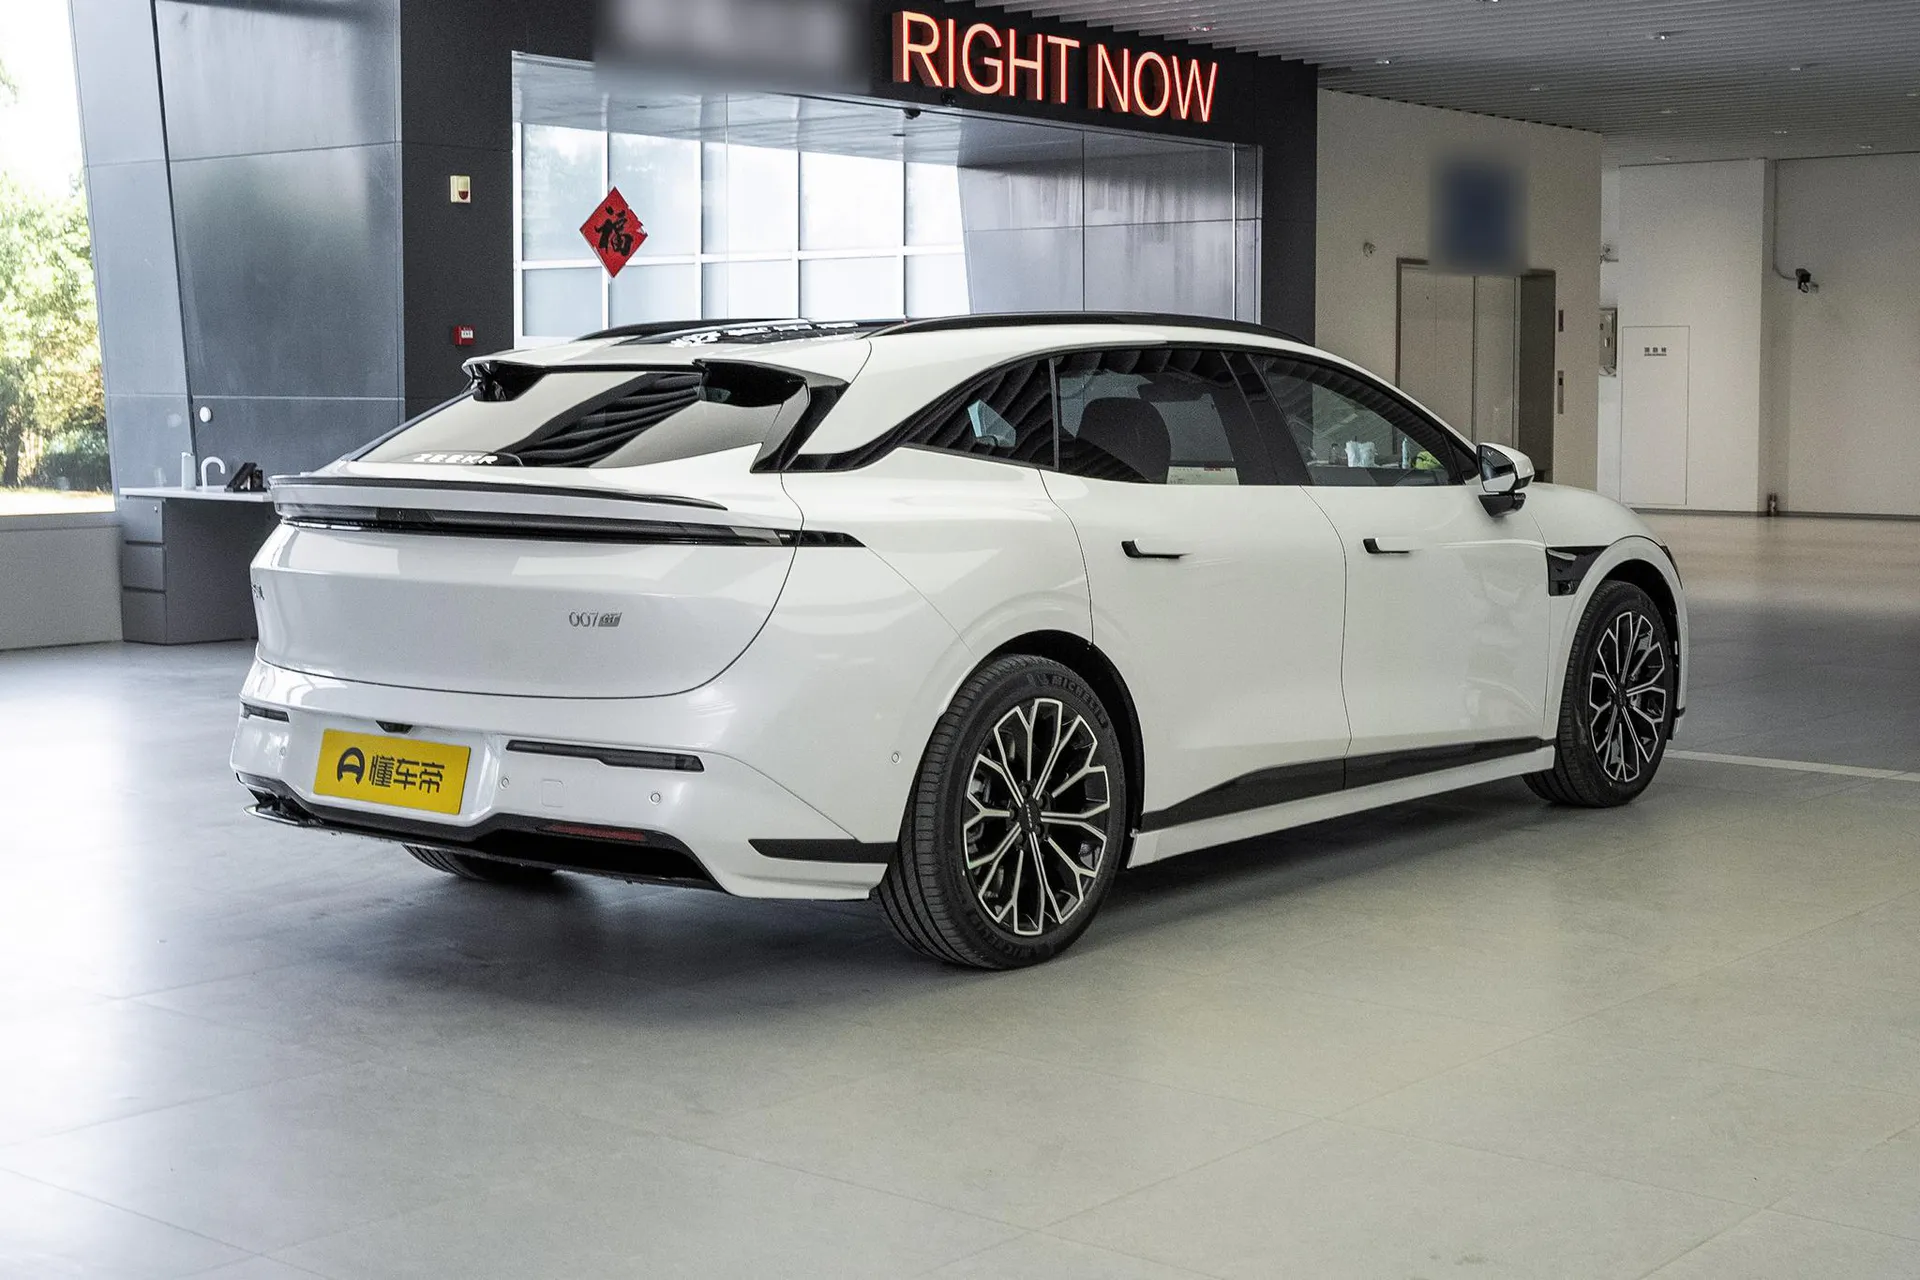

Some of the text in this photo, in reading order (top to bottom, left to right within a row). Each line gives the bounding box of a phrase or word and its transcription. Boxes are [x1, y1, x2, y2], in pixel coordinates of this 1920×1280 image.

[901, 10, 1218, 123] RIGHT NOW
[594, 205, 635, 256] 福
[569, 611, 599, 627] 007
[369, 754, 446, 793] 懂车帝
